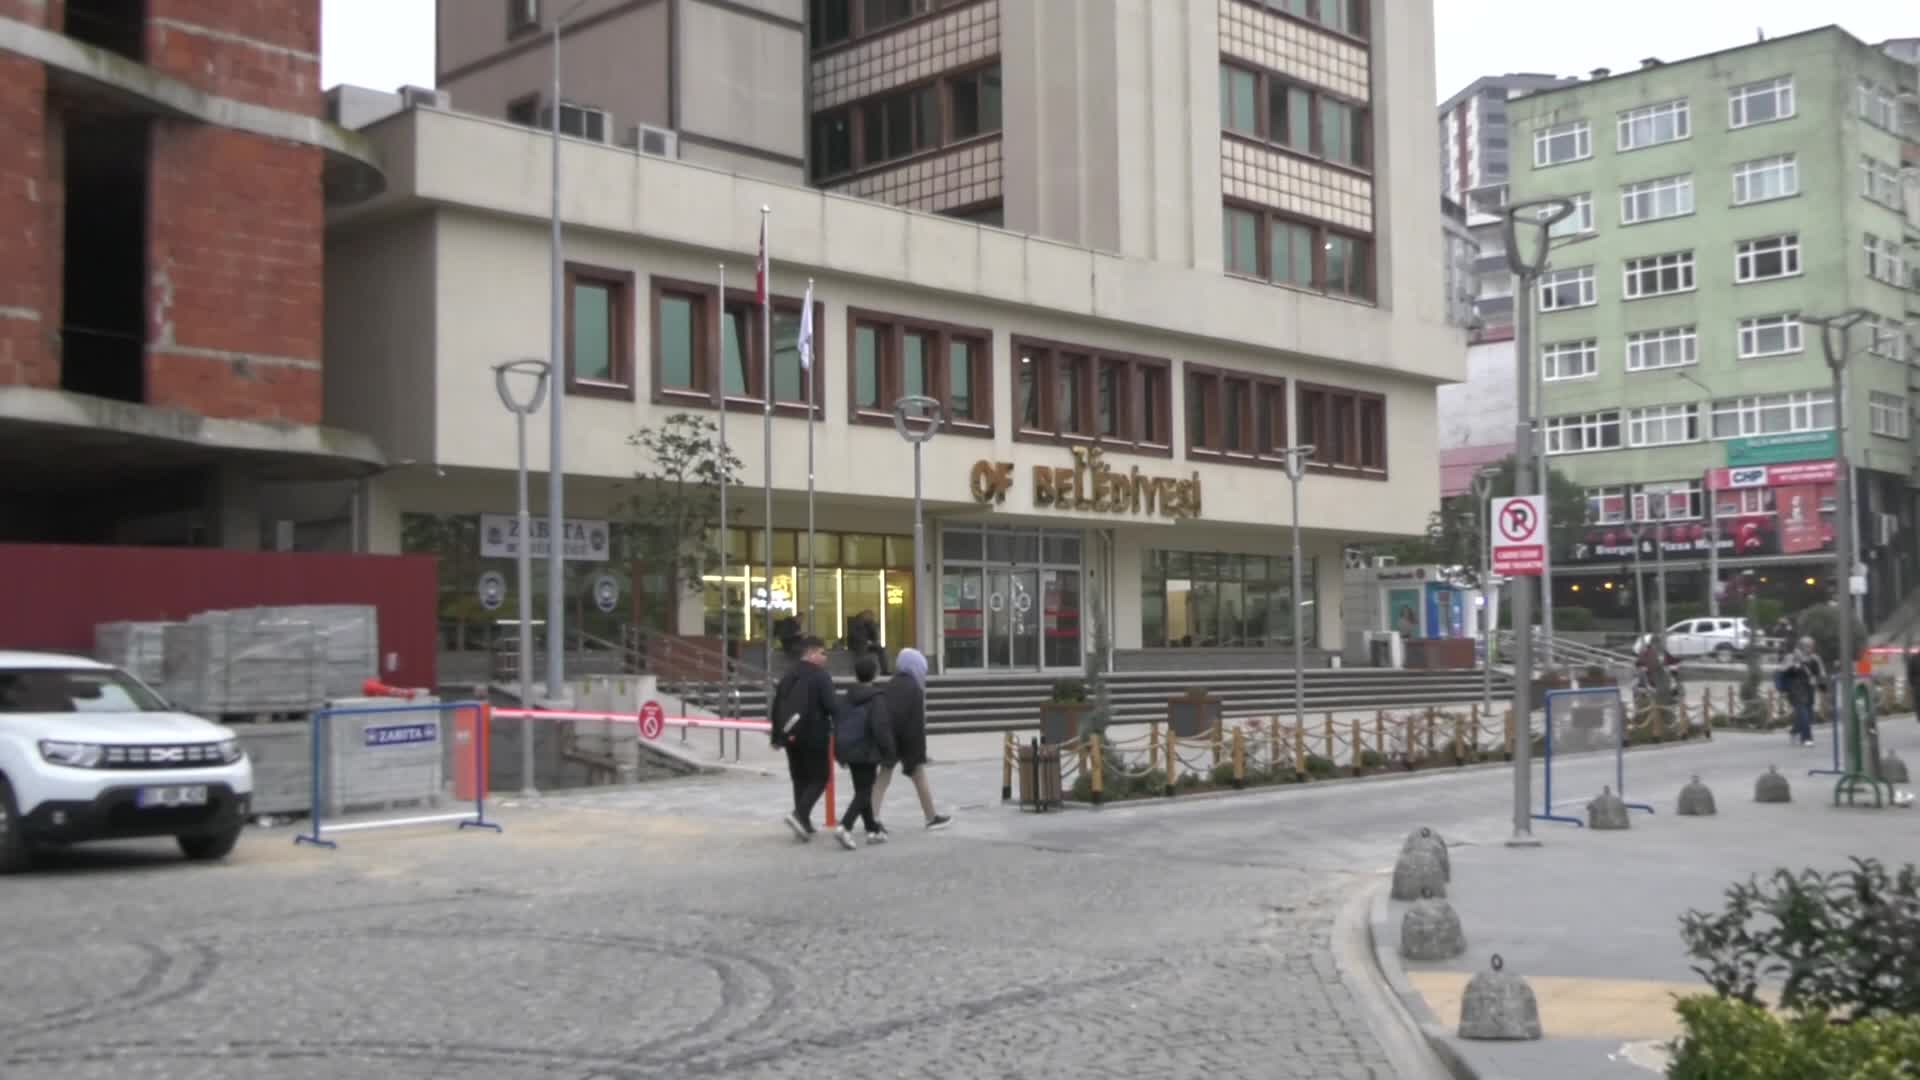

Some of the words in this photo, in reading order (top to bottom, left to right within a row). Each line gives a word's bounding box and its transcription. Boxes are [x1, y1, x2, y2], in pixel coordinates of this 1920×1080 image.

[1732, 469, 1764, 484] CHP
[971, 460, 1014, 503] OF
[1033, 465, 1202, 518] BELEDİYESİ
[509, 520, 585, 540] ZBTA
[1641, 540, 1652, 552] &
[1694, 538, 1734, 550] Hose
